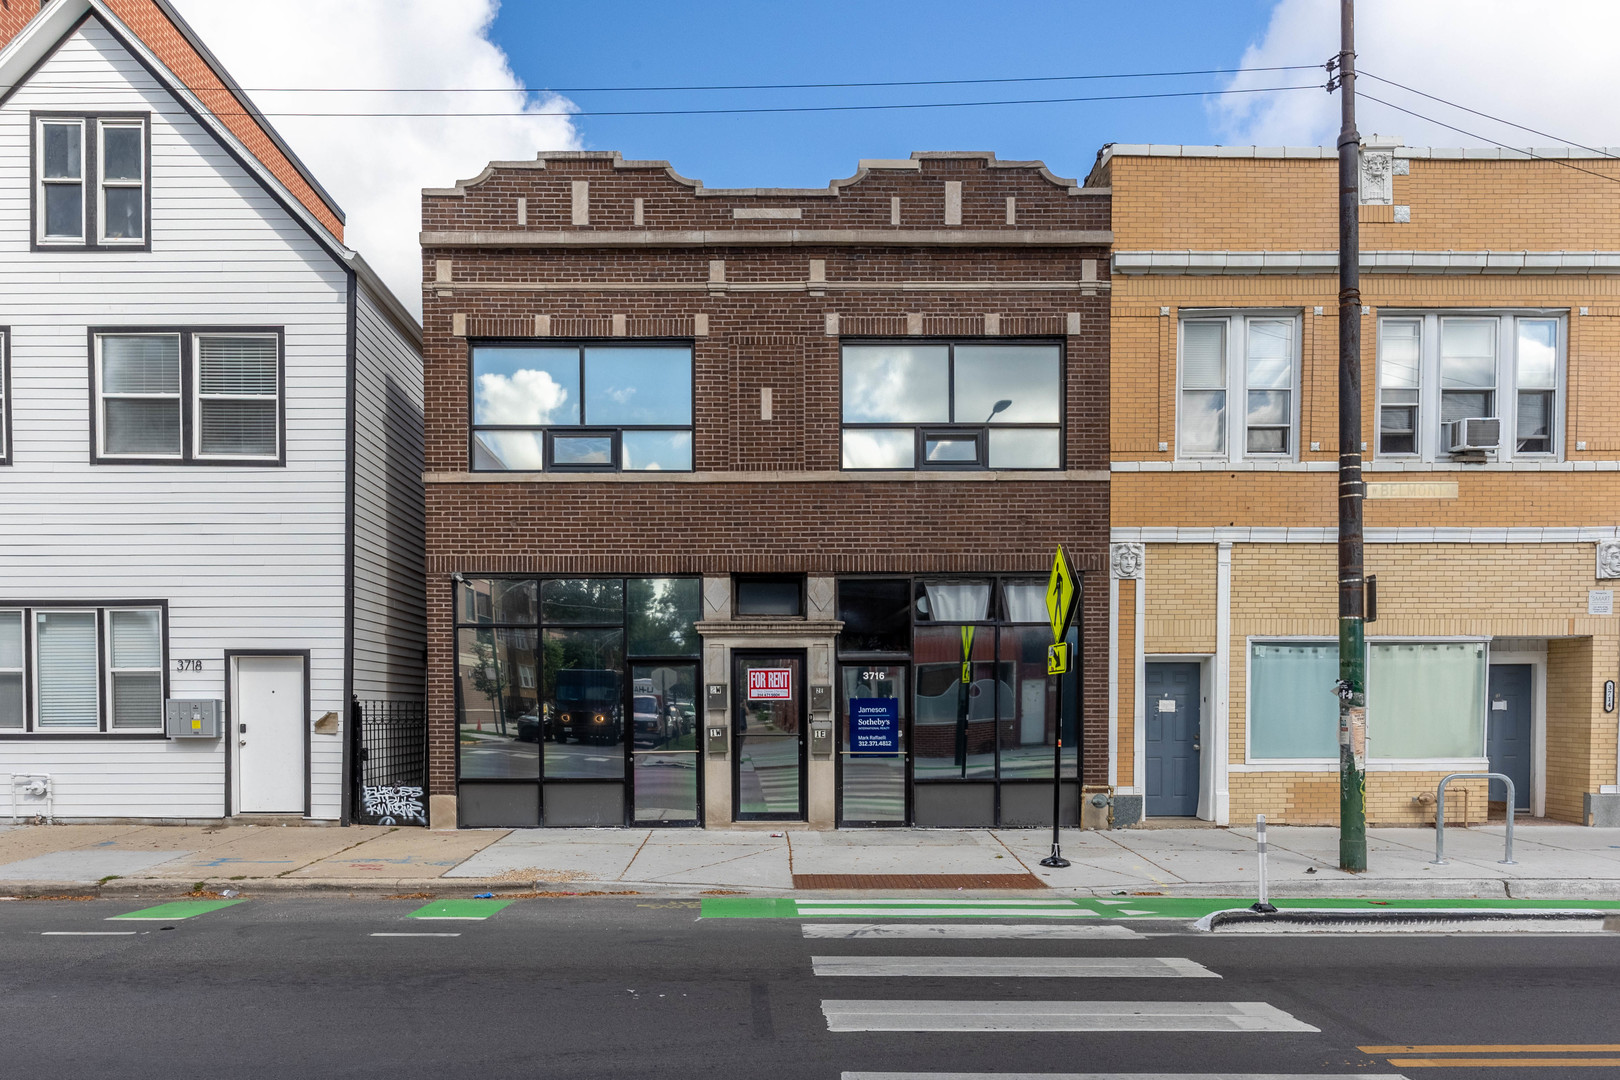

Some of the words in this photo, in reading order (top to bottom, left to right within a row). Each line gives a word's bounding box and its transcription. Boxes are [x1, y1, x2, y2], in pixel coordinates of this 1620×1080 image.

[177, 660, 203, 673] 3718
[751, 672, 766, 688] FOR
[768, 672, 788, 688] RENT
[863, 672, 885, 680] 3716
[858, 718, 890, 727] Sotheby's
